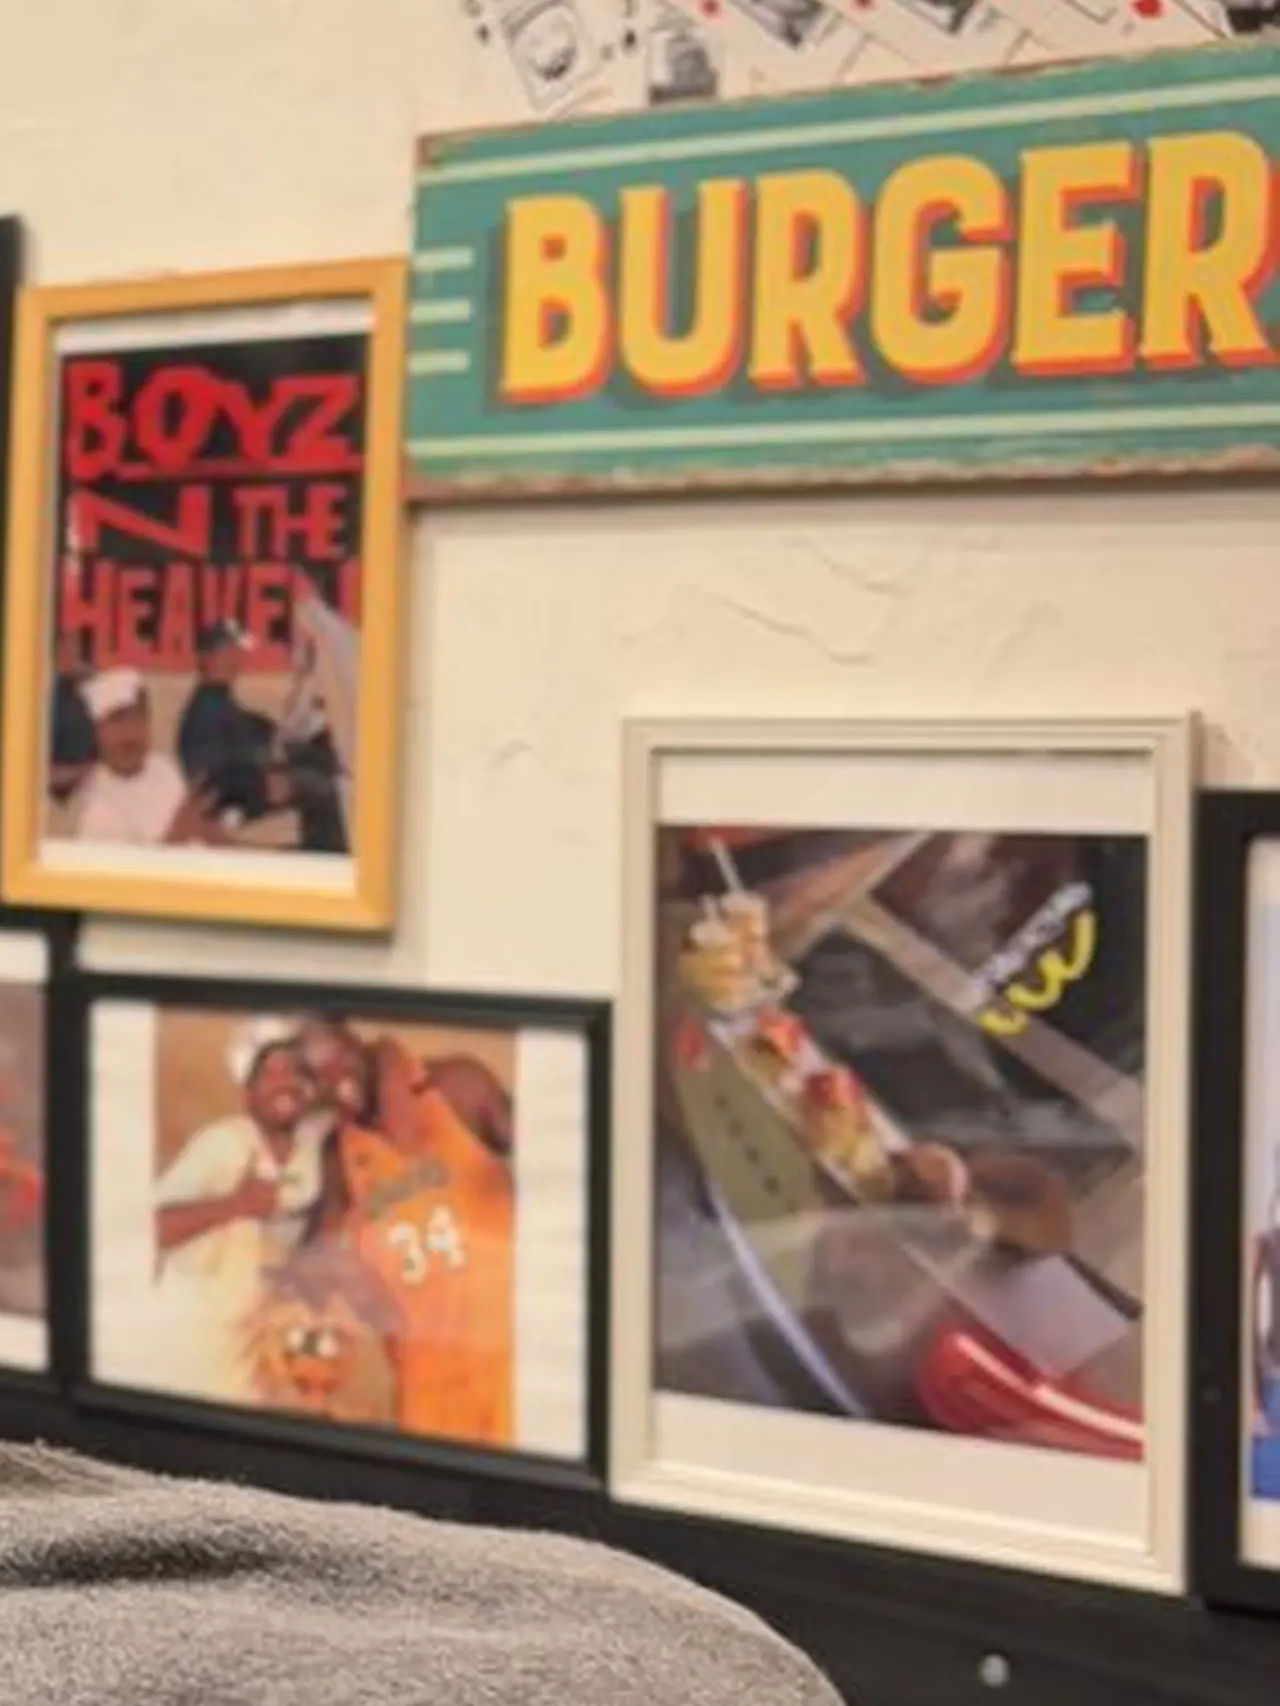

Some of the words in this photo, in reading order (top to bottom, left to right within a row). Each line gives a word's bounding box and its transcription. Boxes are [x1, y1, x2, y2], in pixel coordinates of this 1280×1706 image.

[500, 130, 1280, 404] BURGER
[62, 360, 362, 481] BOYZ
[67, 483, 210, 555] N
[233, 483, 348, 559] THE
[384, 1201, 470, 1289] 34
